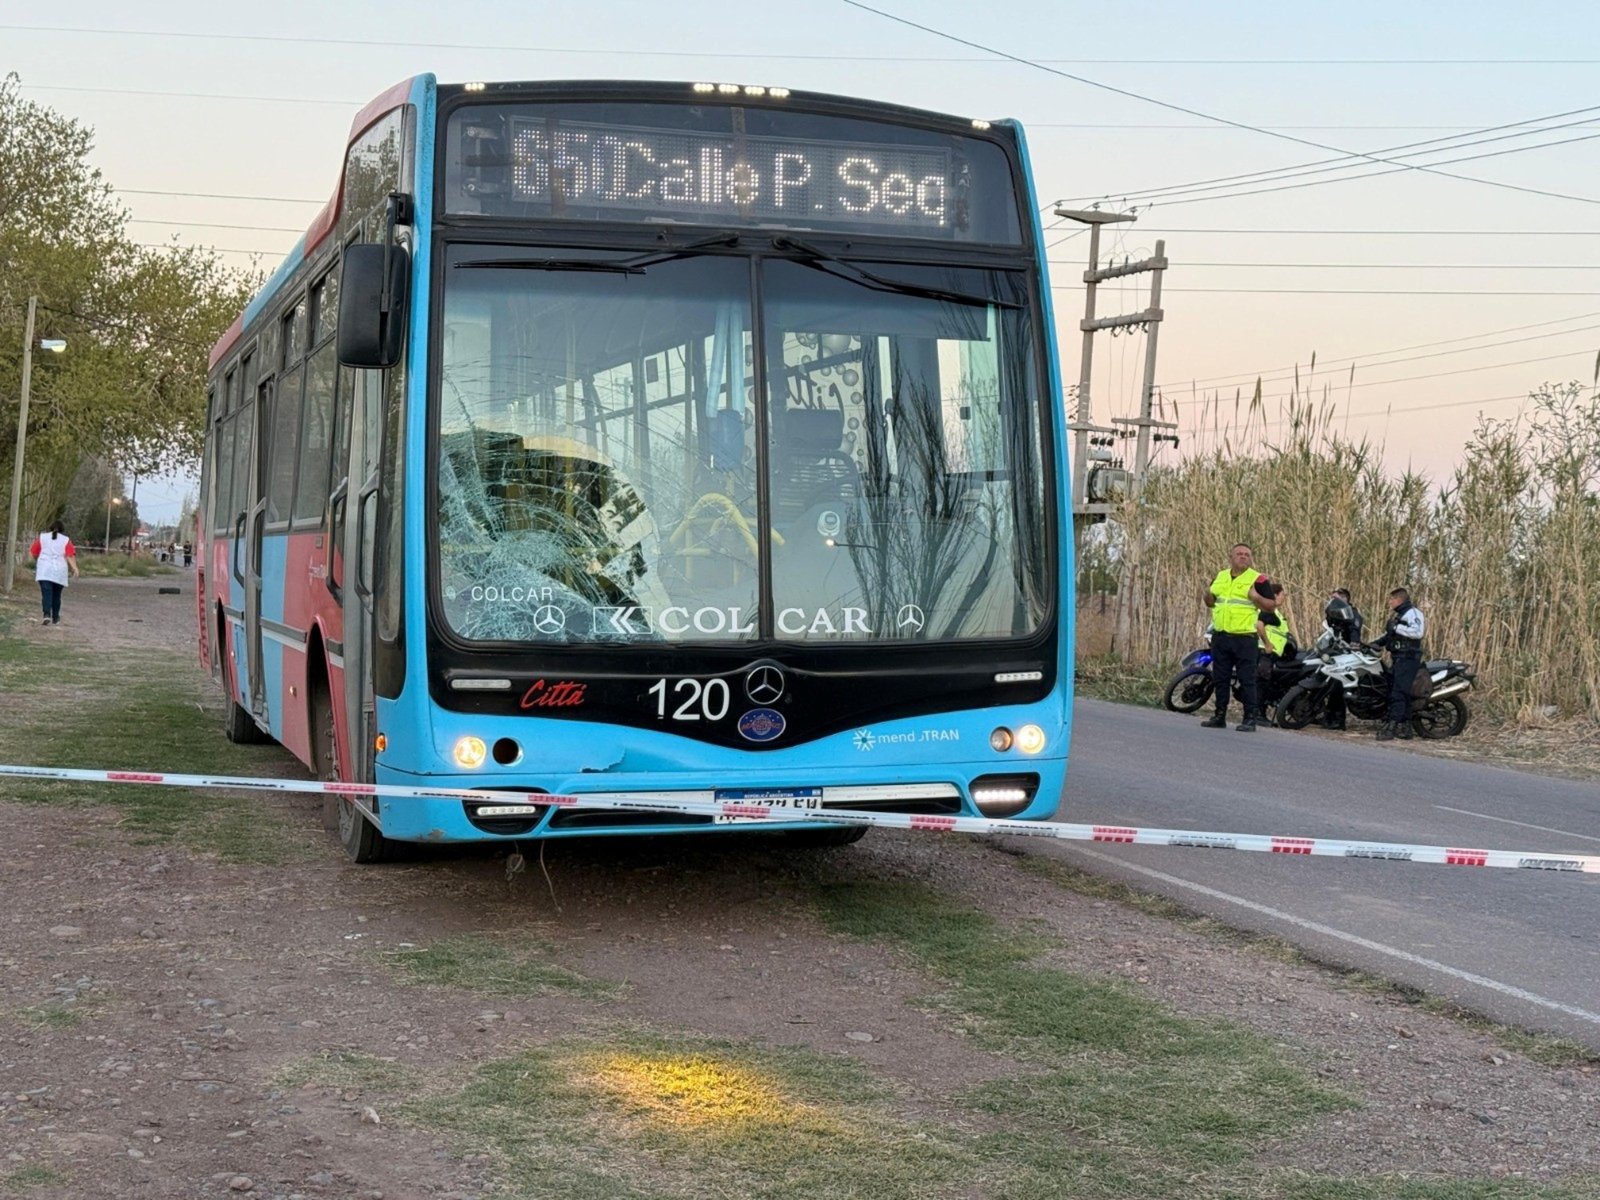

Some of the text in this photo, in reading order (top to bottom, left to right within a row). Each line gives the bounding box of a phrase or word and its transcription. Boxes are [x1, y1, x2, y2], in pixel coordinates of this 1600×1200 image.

[471, 586, 554, 602] COLCAR
[658, 606, 873, 634] COL CAR
[648, 678, 730, 721] 120
